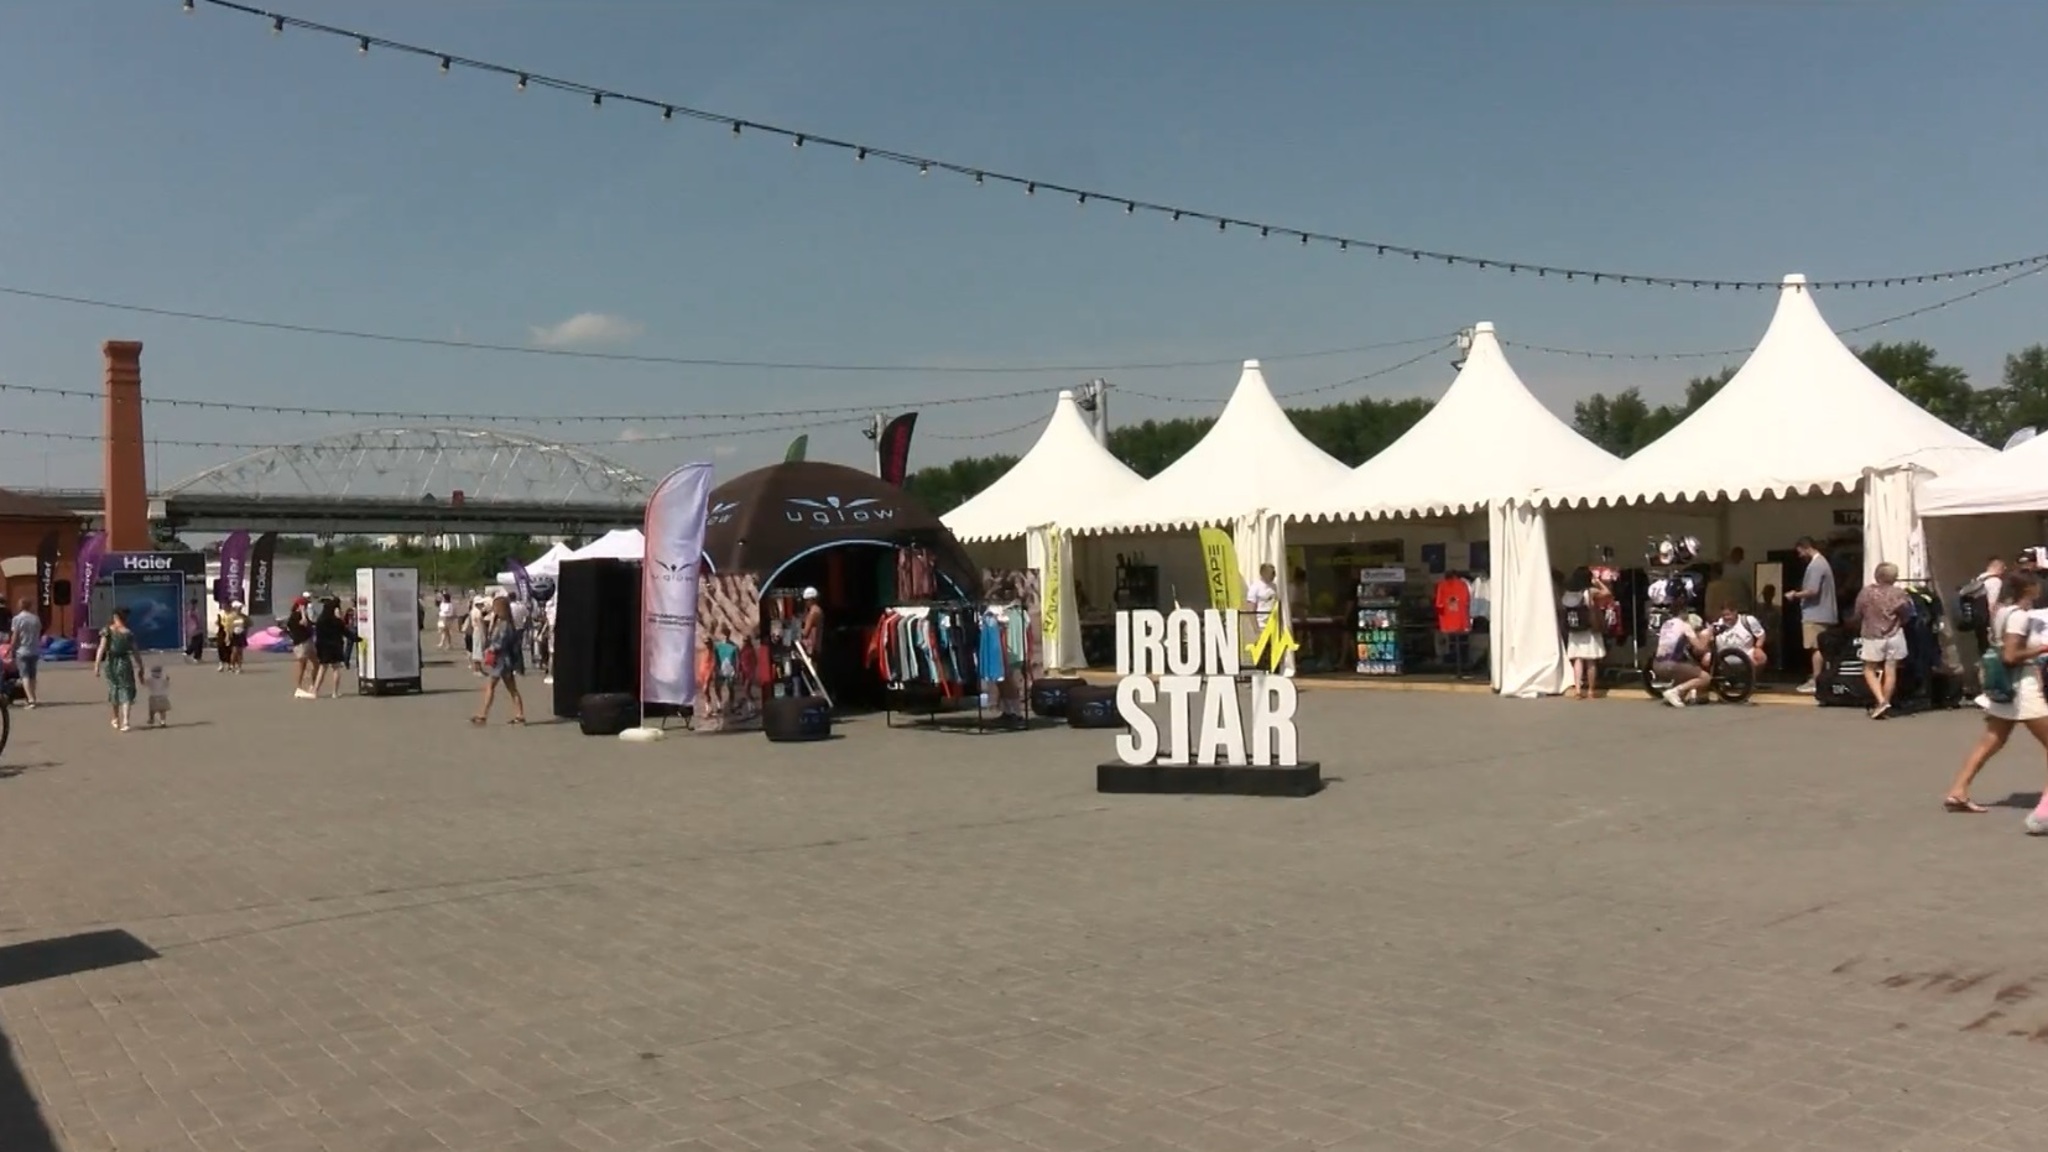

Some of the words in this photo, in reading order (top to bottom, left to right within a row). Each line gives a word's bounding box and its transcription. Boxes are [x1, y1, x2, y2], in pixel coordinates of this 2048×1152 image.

[786, 509, 893, 525] uglow
[124, 555, 172, 569] Haier
[226, 558, 240, 600] Haier
[256, 559, 268, 601] Haier
[1115, 608, 1239, 675] IRON
[1115, 674, 1297, 766] STAR
